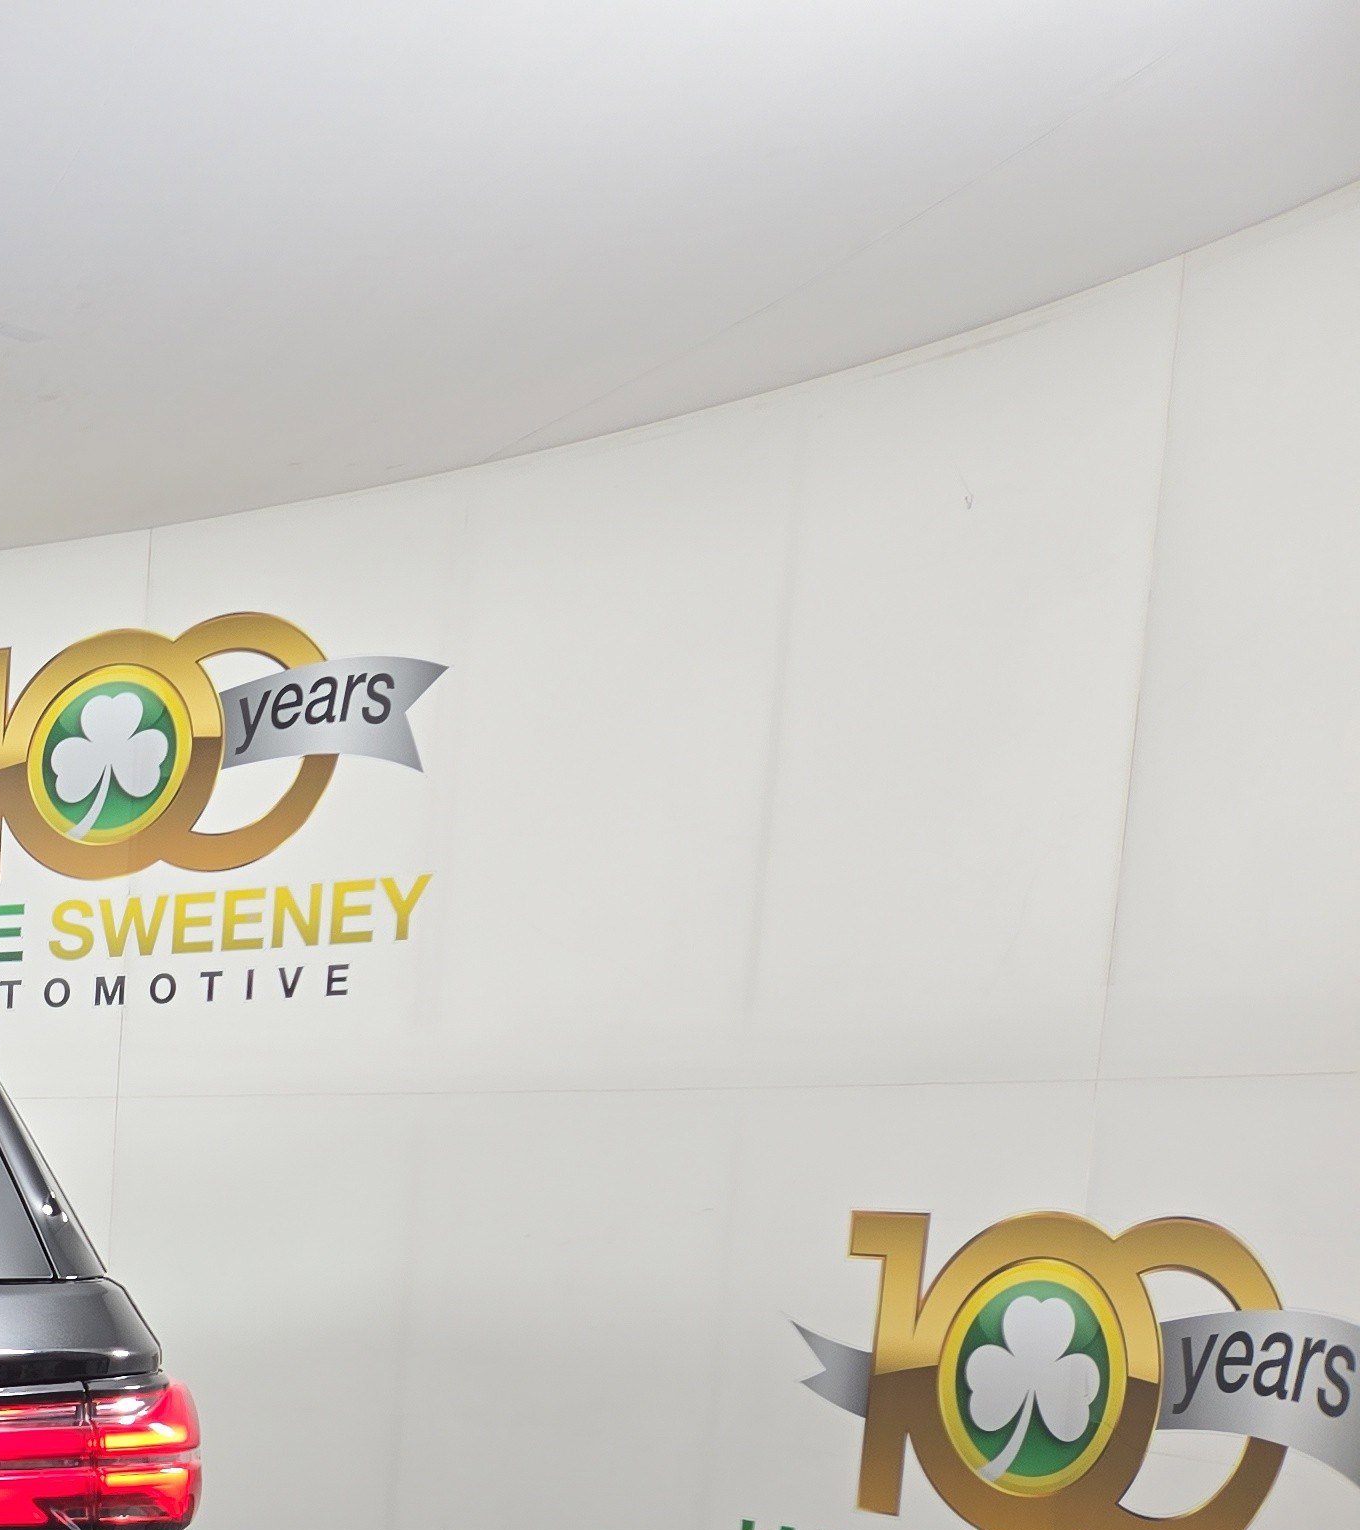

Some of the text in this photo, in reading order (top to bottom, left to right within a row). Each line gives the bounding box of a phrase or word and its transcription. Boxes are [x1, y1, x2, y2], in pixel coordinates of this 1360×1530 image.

[234, 672, 395, 755] years
[48, 874, 433, 962] SWEENEY
[1172, 1328, 1357, 1418] years
